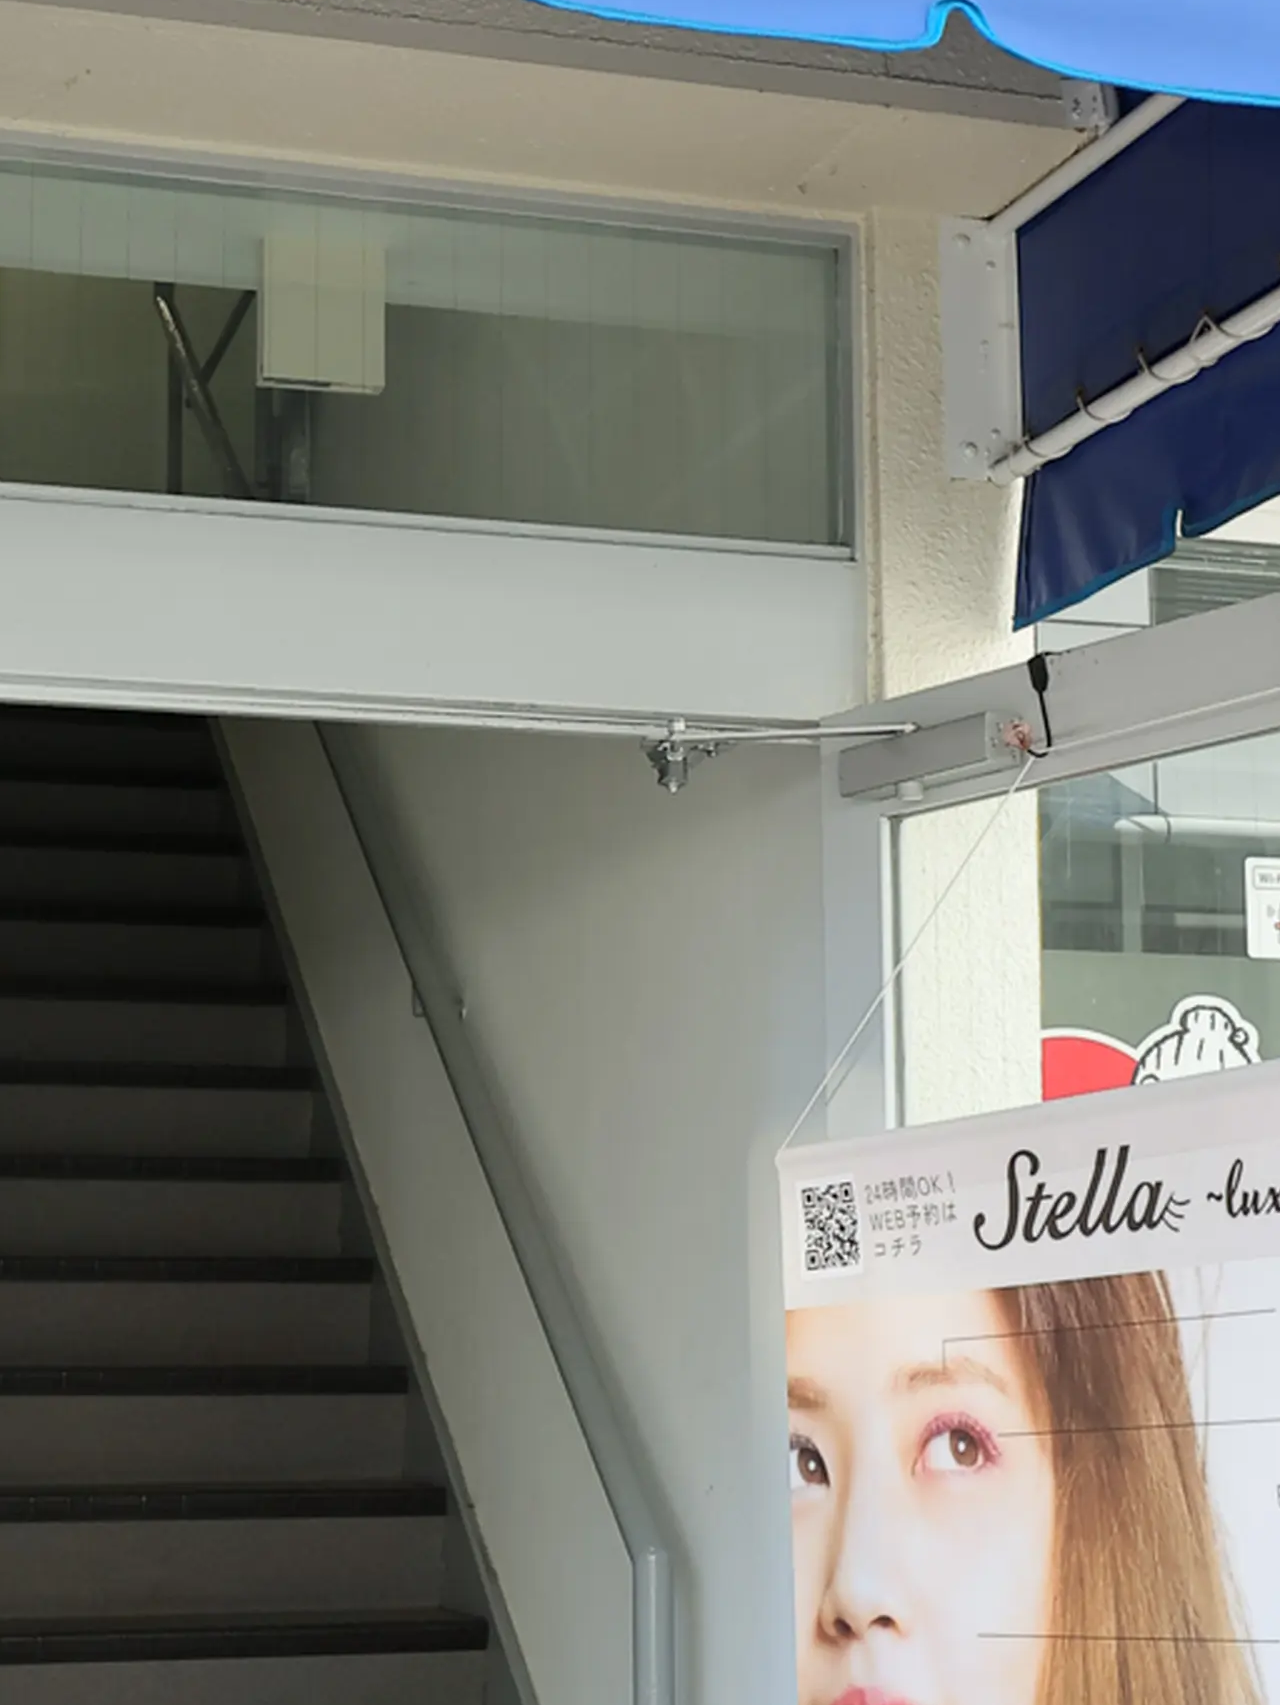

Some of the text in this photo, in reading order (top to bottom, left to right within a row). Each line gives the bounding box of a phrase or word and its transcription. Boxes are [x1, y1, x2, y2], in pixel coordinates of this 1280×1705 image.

[973, 1144, 1164, 1251] Stella
[870, 1202, 958, 1231] WEB予約は
[874, 1234, 923, 1258] コチラ
